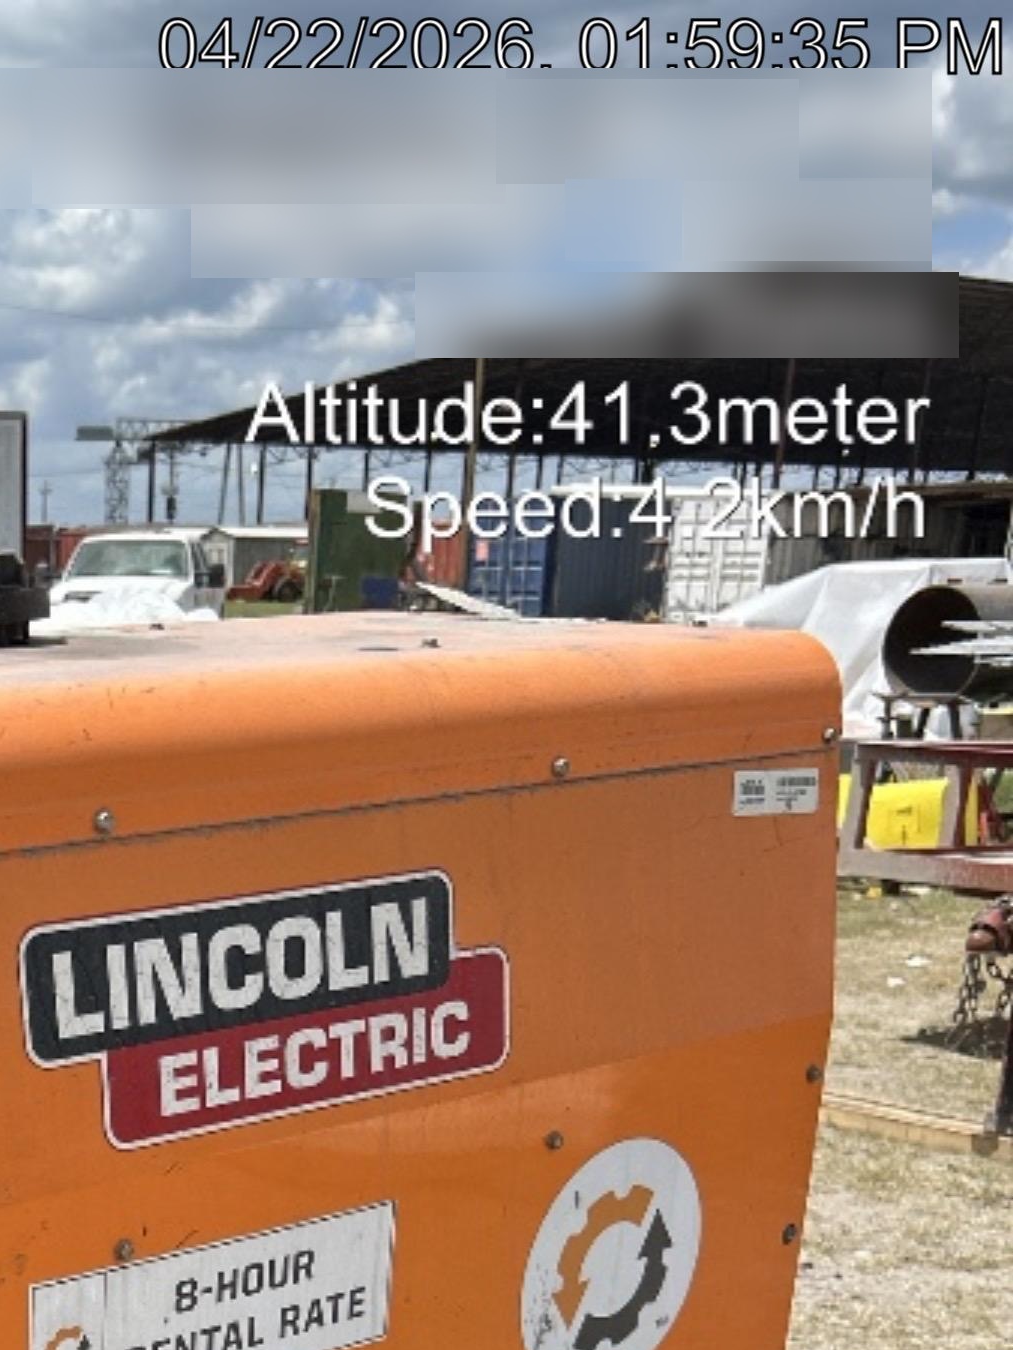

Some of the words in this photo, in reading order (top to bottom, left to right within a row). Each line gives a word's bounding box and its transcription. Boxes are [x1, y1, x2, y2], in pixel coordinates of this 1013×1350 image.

[52, 897, 430, 1040] LINCOLN
[158, 1000, 470, 1118] ELECTRIC
[174, 1249, 315, 1314] 8-HOUR
[278, 1286, 367, 1339] RATE
